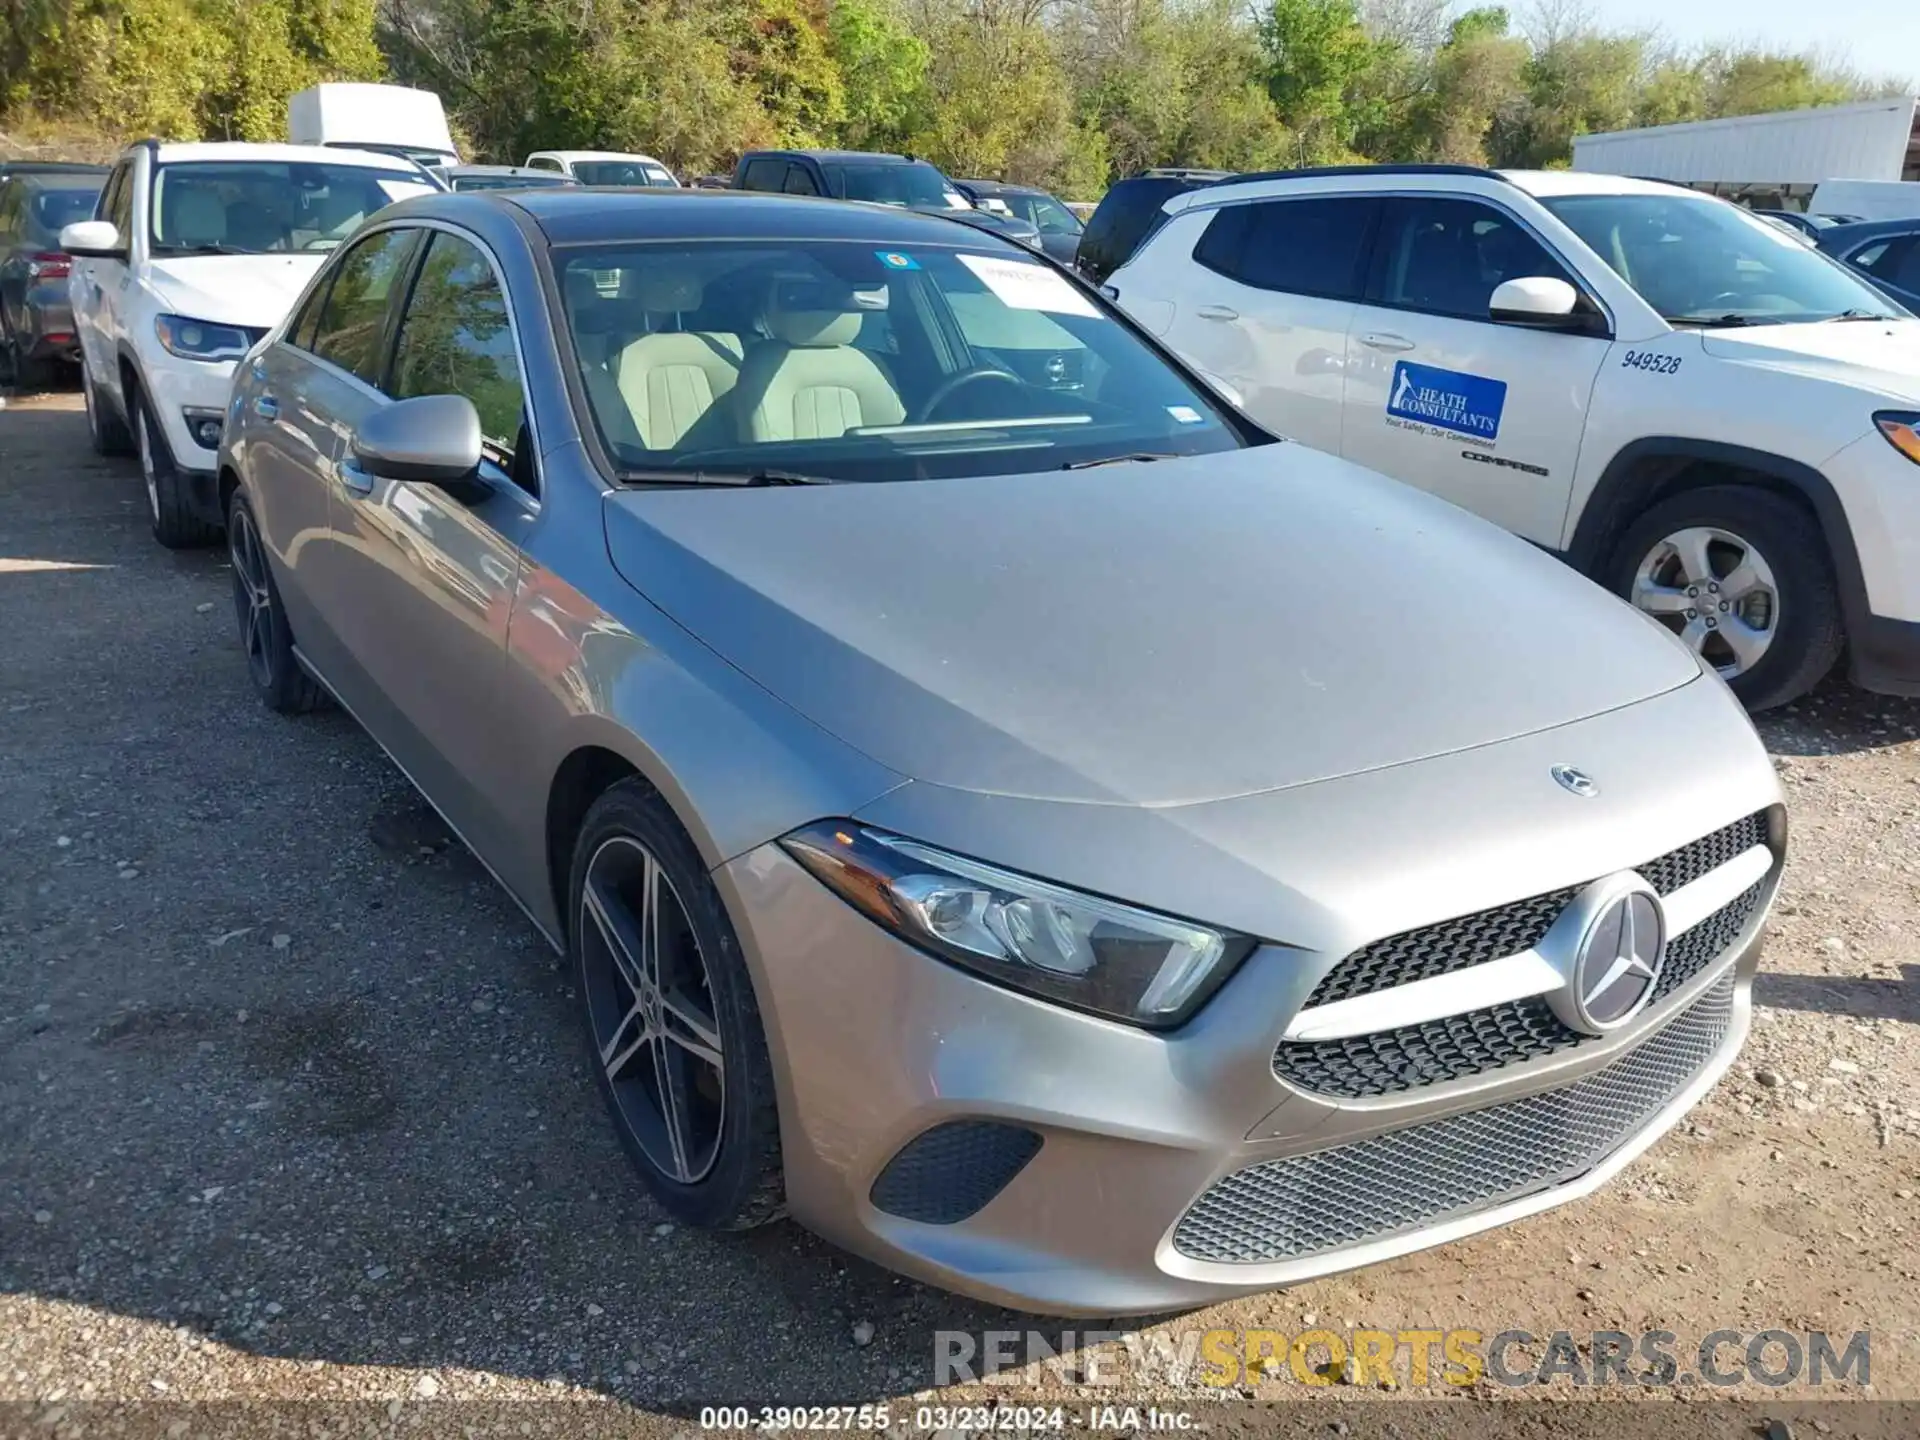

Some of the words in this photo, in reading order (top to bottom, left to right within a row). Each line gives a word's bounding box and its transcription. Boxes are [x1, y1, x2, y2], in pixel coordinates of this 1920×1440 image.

[1621, 350, 1682, 374] 949528
[1418, 387, 1467, 411] HEATH
[1400, 397, 1496, 431] CONSULTANTS
[1461, 450, 1549, 477] COMPASS
